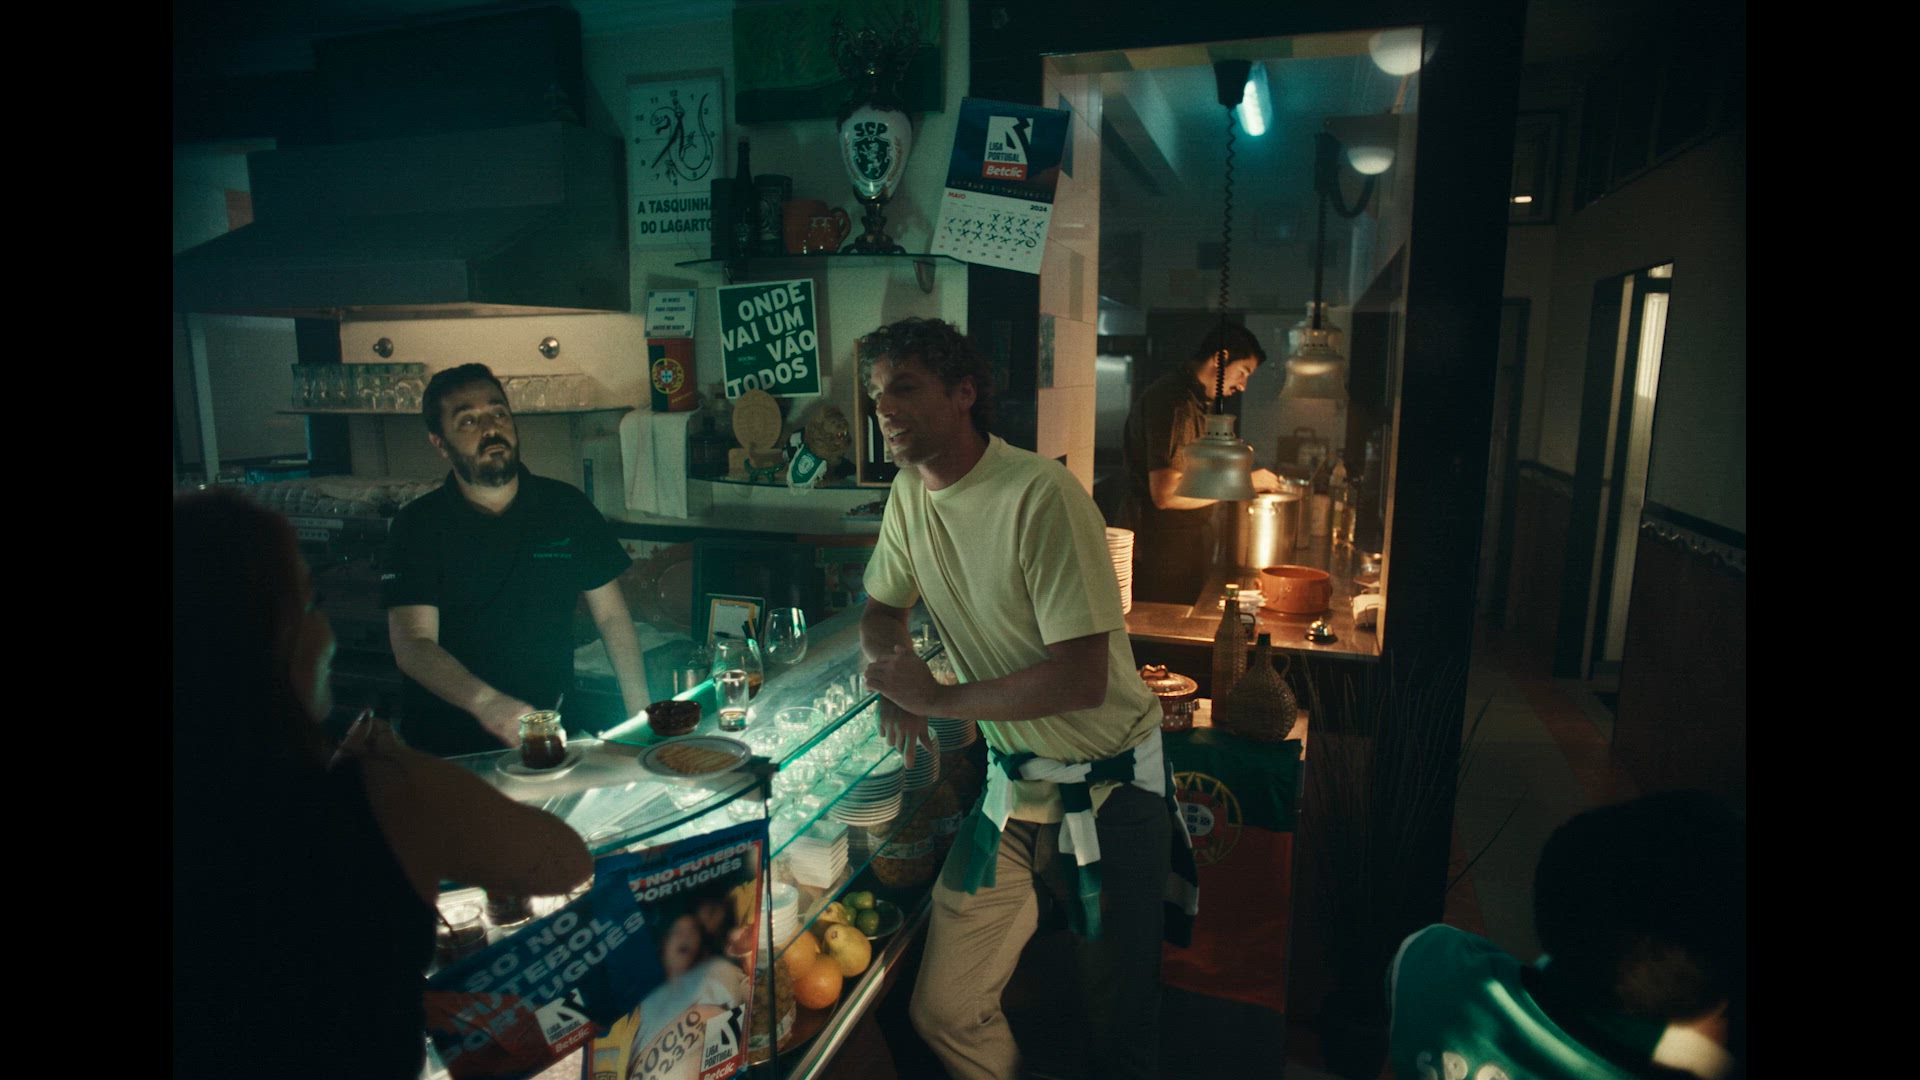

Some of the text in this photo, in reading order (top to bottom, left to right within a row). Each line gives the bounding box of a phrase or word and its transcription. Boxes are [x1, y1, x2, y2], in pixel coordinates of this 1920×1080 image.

[854, 121, 887, 136] SCP
[989, 142, 1003, 151] LIGA
[987, 151, 1020, 162] PORTUGAL
[986, 165, 1023, 178] Betclic
[947, 191, 966, 199] MAIO
[637, 201, 646, 214] A
[1030, 204, 1048, 212] 2024
[641, 220, 657, 234] DO
[737, 282, 806, 322] ONDE
[722, 305, 804, 352] VAI UM
[765, 329, 817, 363] VÃO
[726, 356, 809, 399] TODOS
[526, 911, 579, 953] NO
[555, 1027, 590, 1053] Betclic
[705, 1044, 719, 1058] LIGA
[704, 1048, 733, 1070] PORTUGAL
